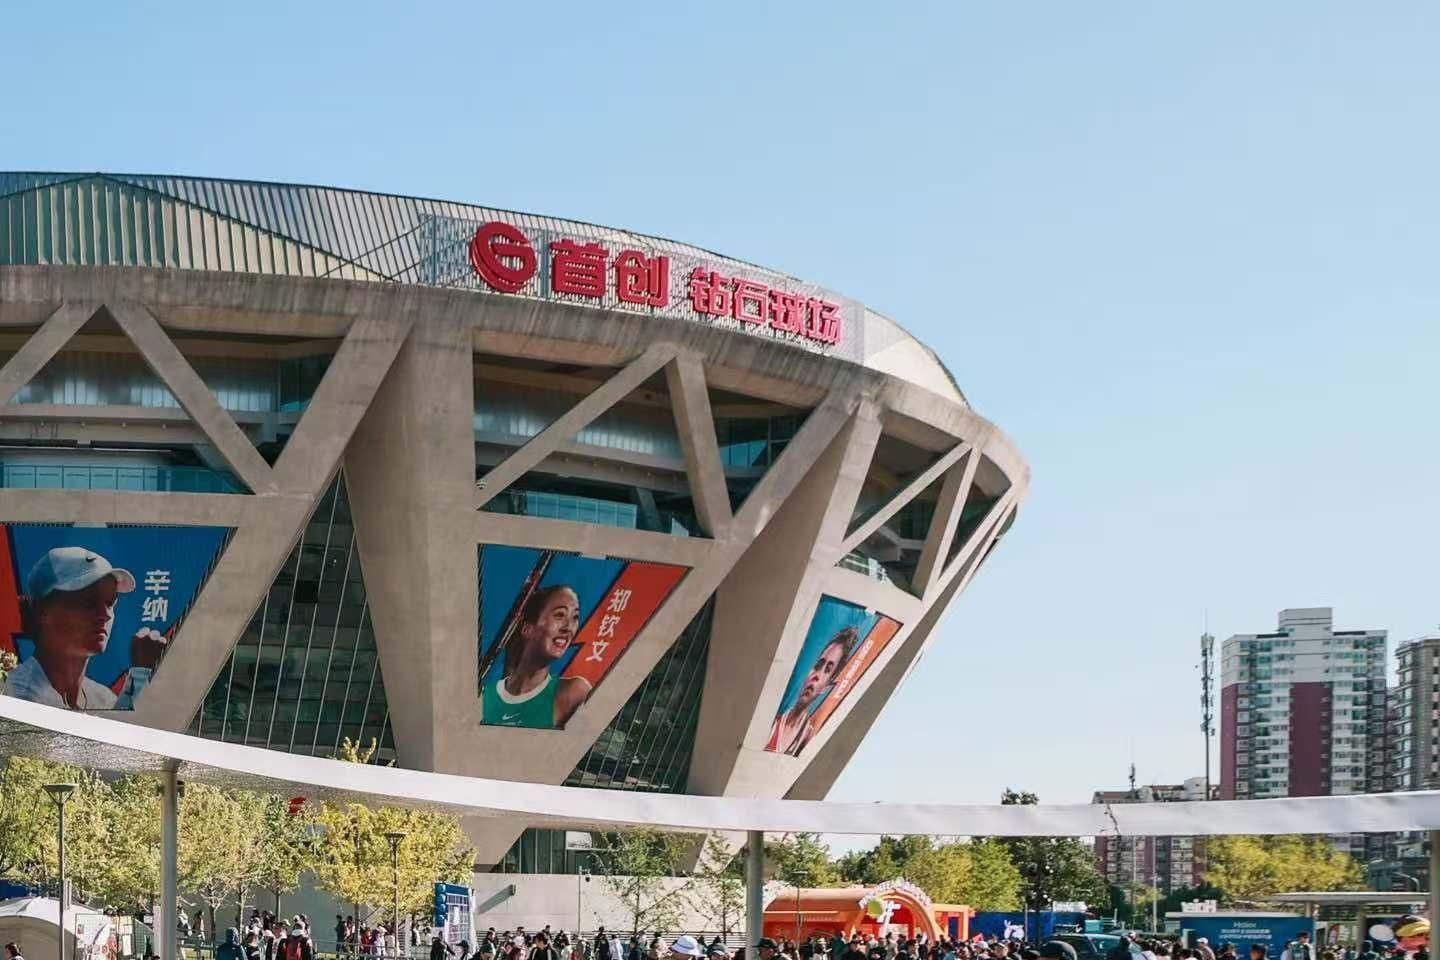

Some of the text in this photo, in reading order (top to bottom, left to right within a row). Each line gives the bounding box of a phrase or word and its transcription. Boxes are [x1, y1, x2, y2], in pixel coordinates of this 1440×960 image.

[551, 238, 842, 345] 首创 钻石球场
[141, 569, 171, 622] 辛纳
[585, 589, 632, 662] 郑钦文
